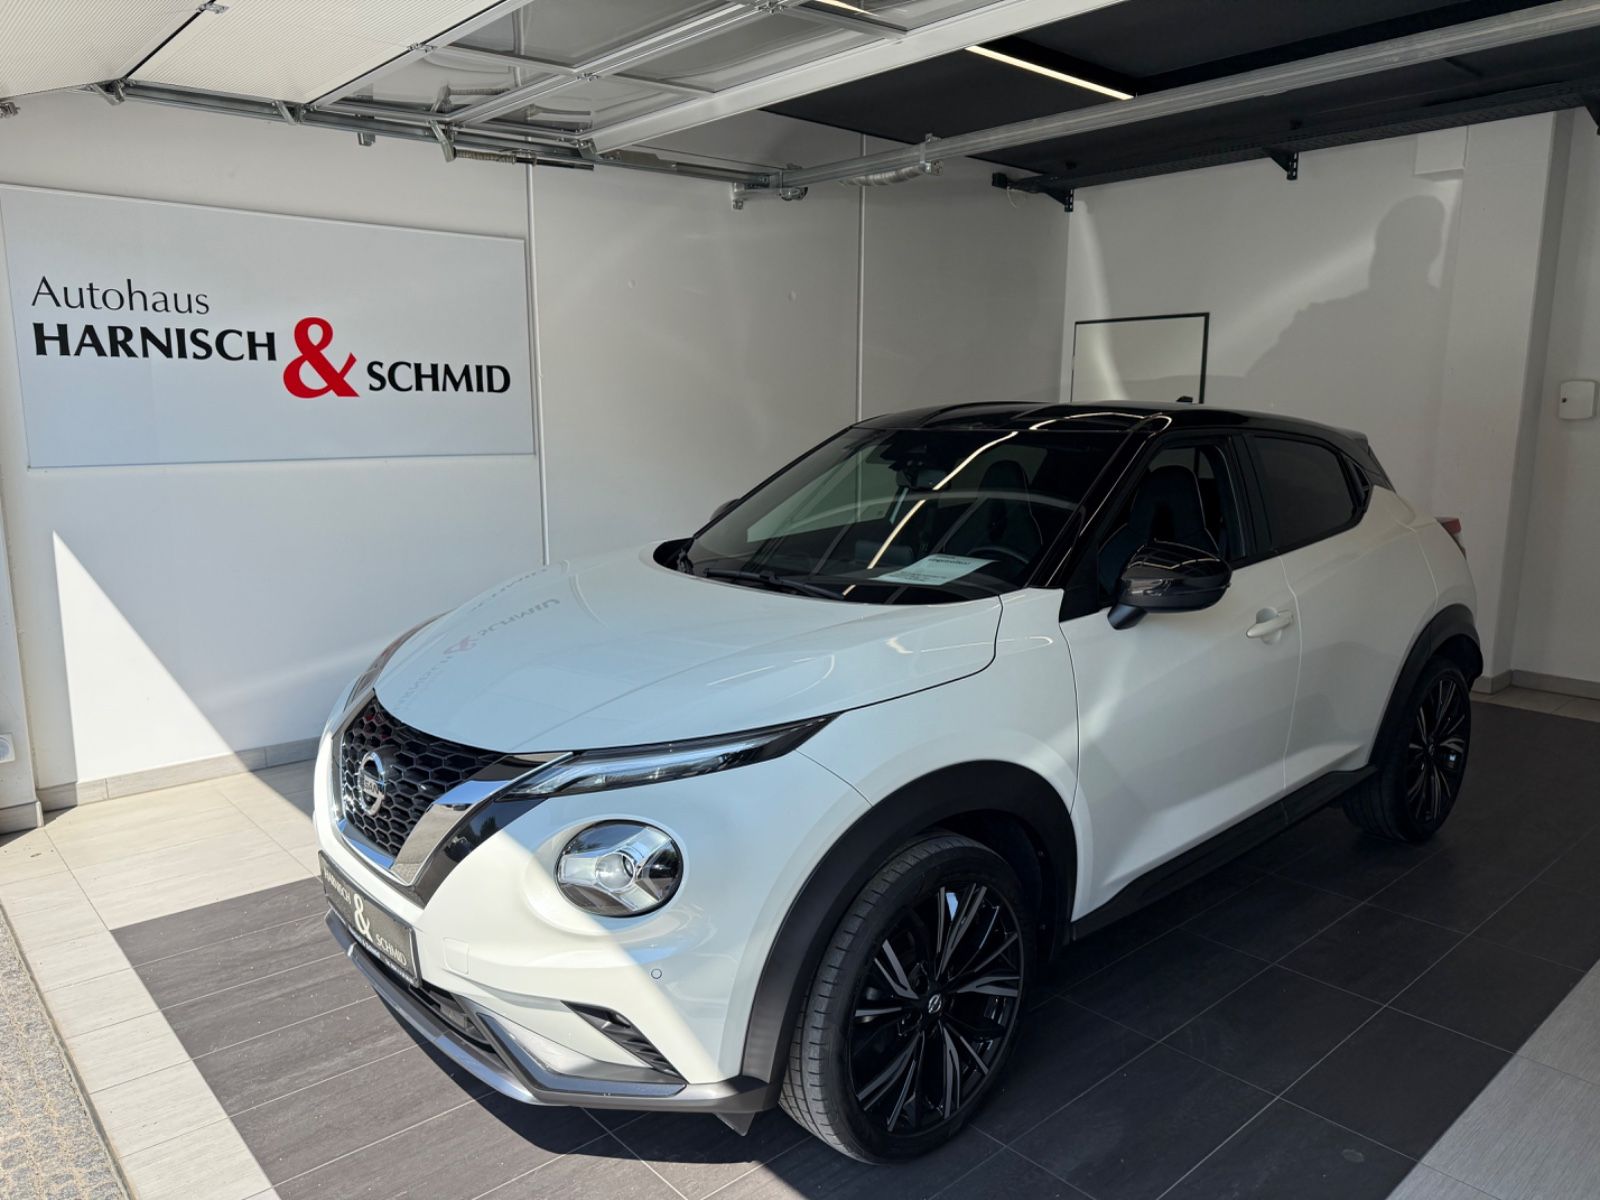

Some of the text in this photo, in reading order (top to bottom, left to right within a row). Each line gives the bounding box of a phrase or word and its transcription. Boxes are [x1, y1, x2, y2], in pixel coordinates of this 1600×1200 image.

[32, 275, 210, 315] Autohaus
[33, 316, 511, 399] HARNISCH & SCHMID
[353, 893, 374, 943] &
[375, 933, 408, 967] SCHMID
